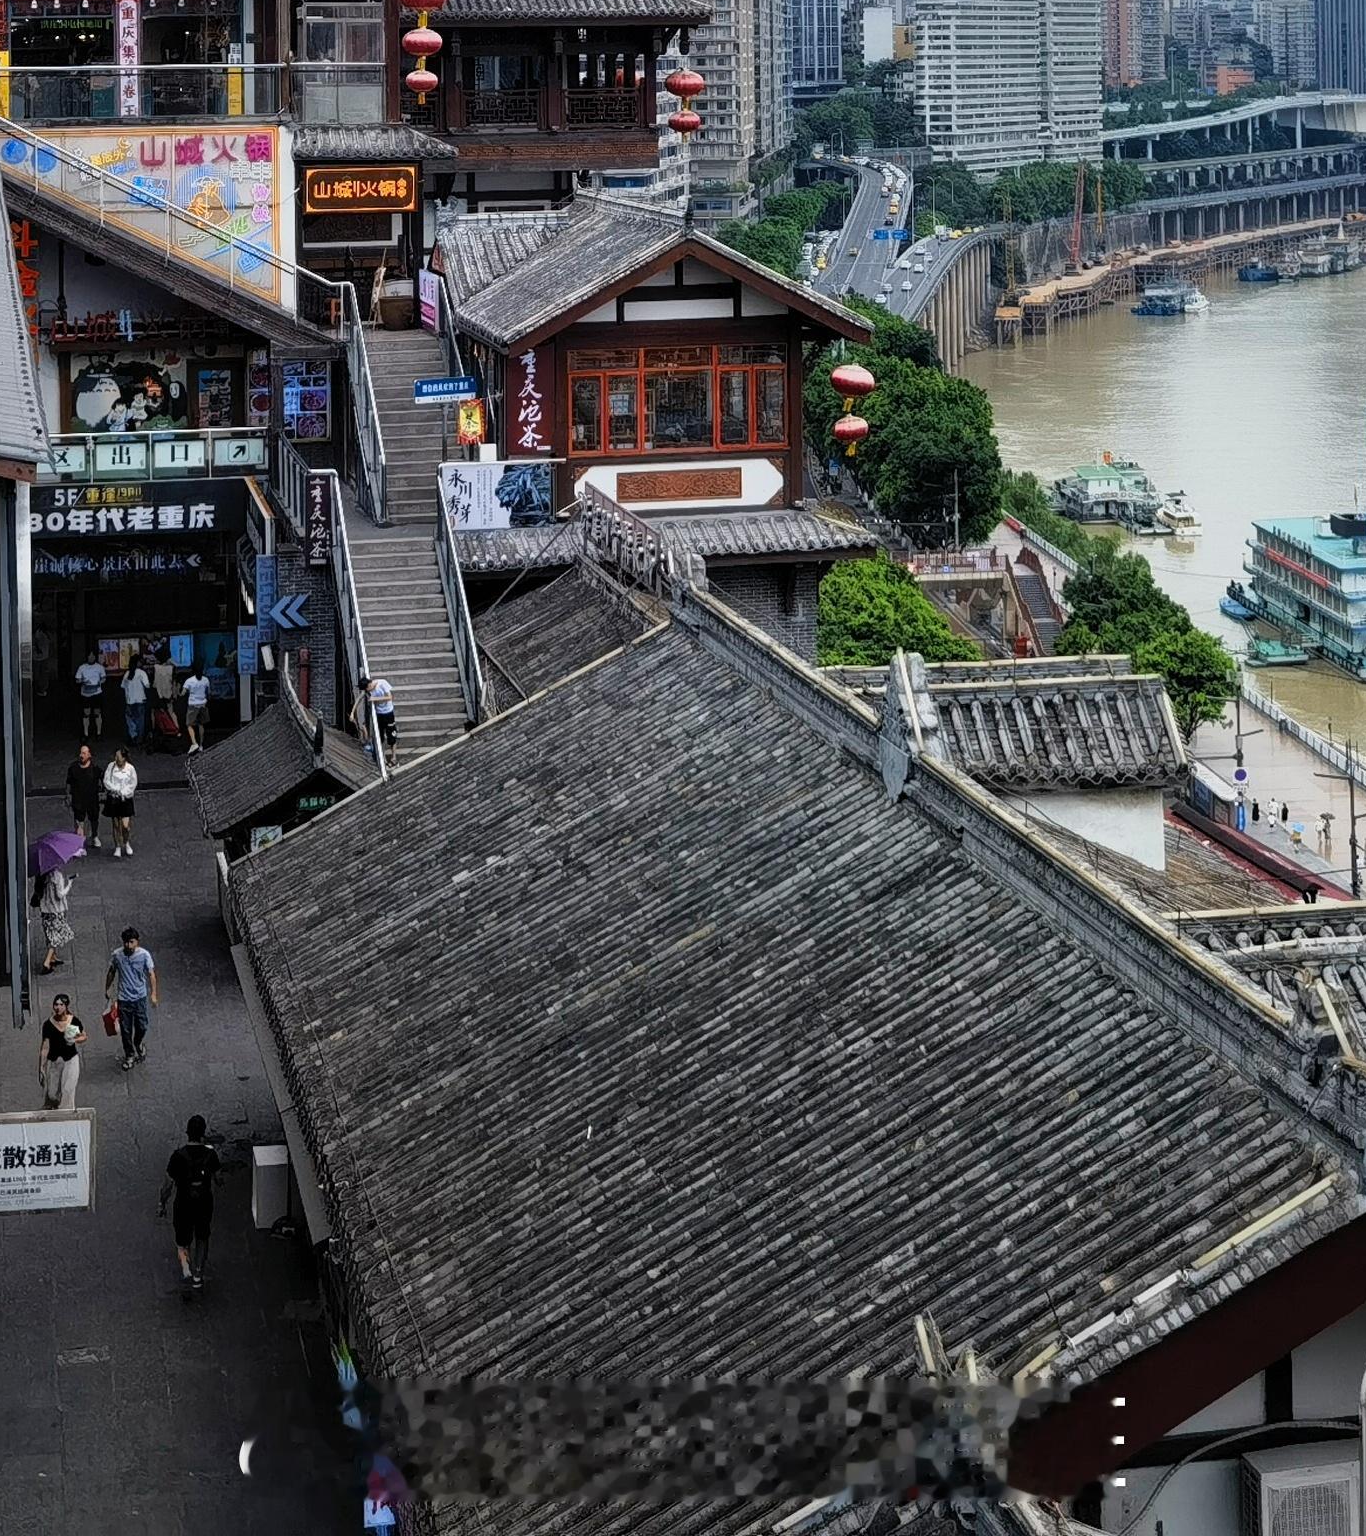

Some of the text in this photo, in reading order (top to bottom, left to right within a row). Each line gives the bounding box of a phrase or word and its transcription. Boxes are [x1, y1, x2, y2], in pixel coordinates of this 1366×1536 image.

[140, 134, 273, 165] 山城火锅
[517, 349, 543, 448] 重庆沱茶
